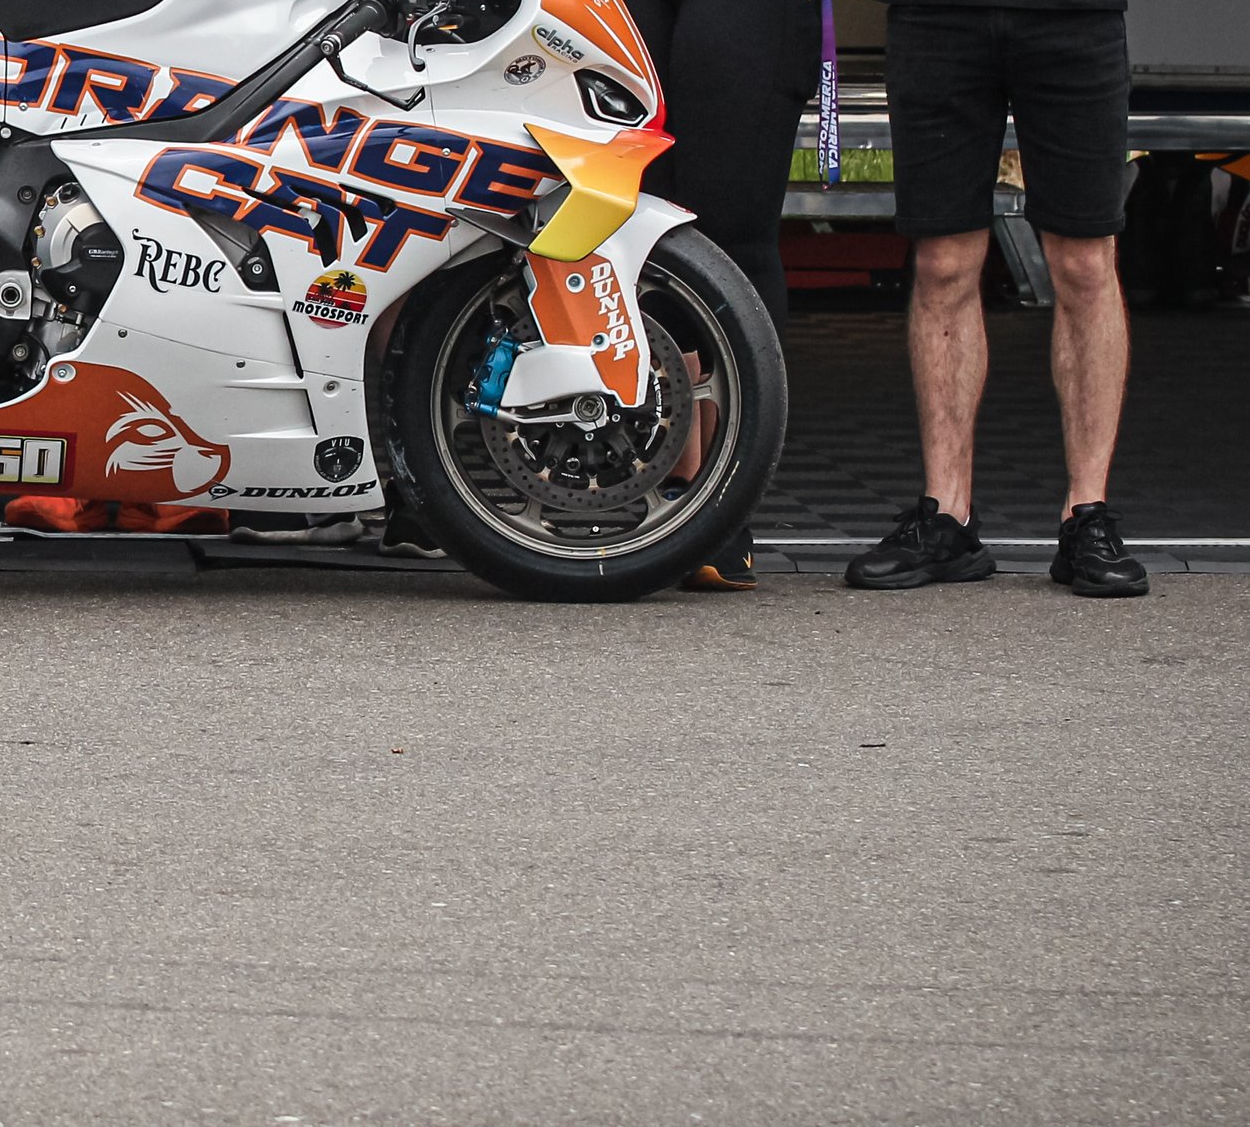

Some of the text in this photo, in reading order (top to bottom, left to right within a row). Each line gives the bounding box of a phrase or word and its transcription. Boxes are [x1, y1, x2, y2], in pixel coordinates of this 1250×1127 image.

[536, 27, 586, 61] alpha
[551, 45, 579, 64] RACING
[818, 60, 833, 174] MOTOAMERICA
[134, 147, 456, 273] CAT
[132, 228, 226, 294] REBC
[292, 300, 369, 325] MOTOSPORT
[590, 262, 635, 362] DUNLOP
[331, 439, 351, 448] VIU
[239, 480, 378, 499] DUNLOP
